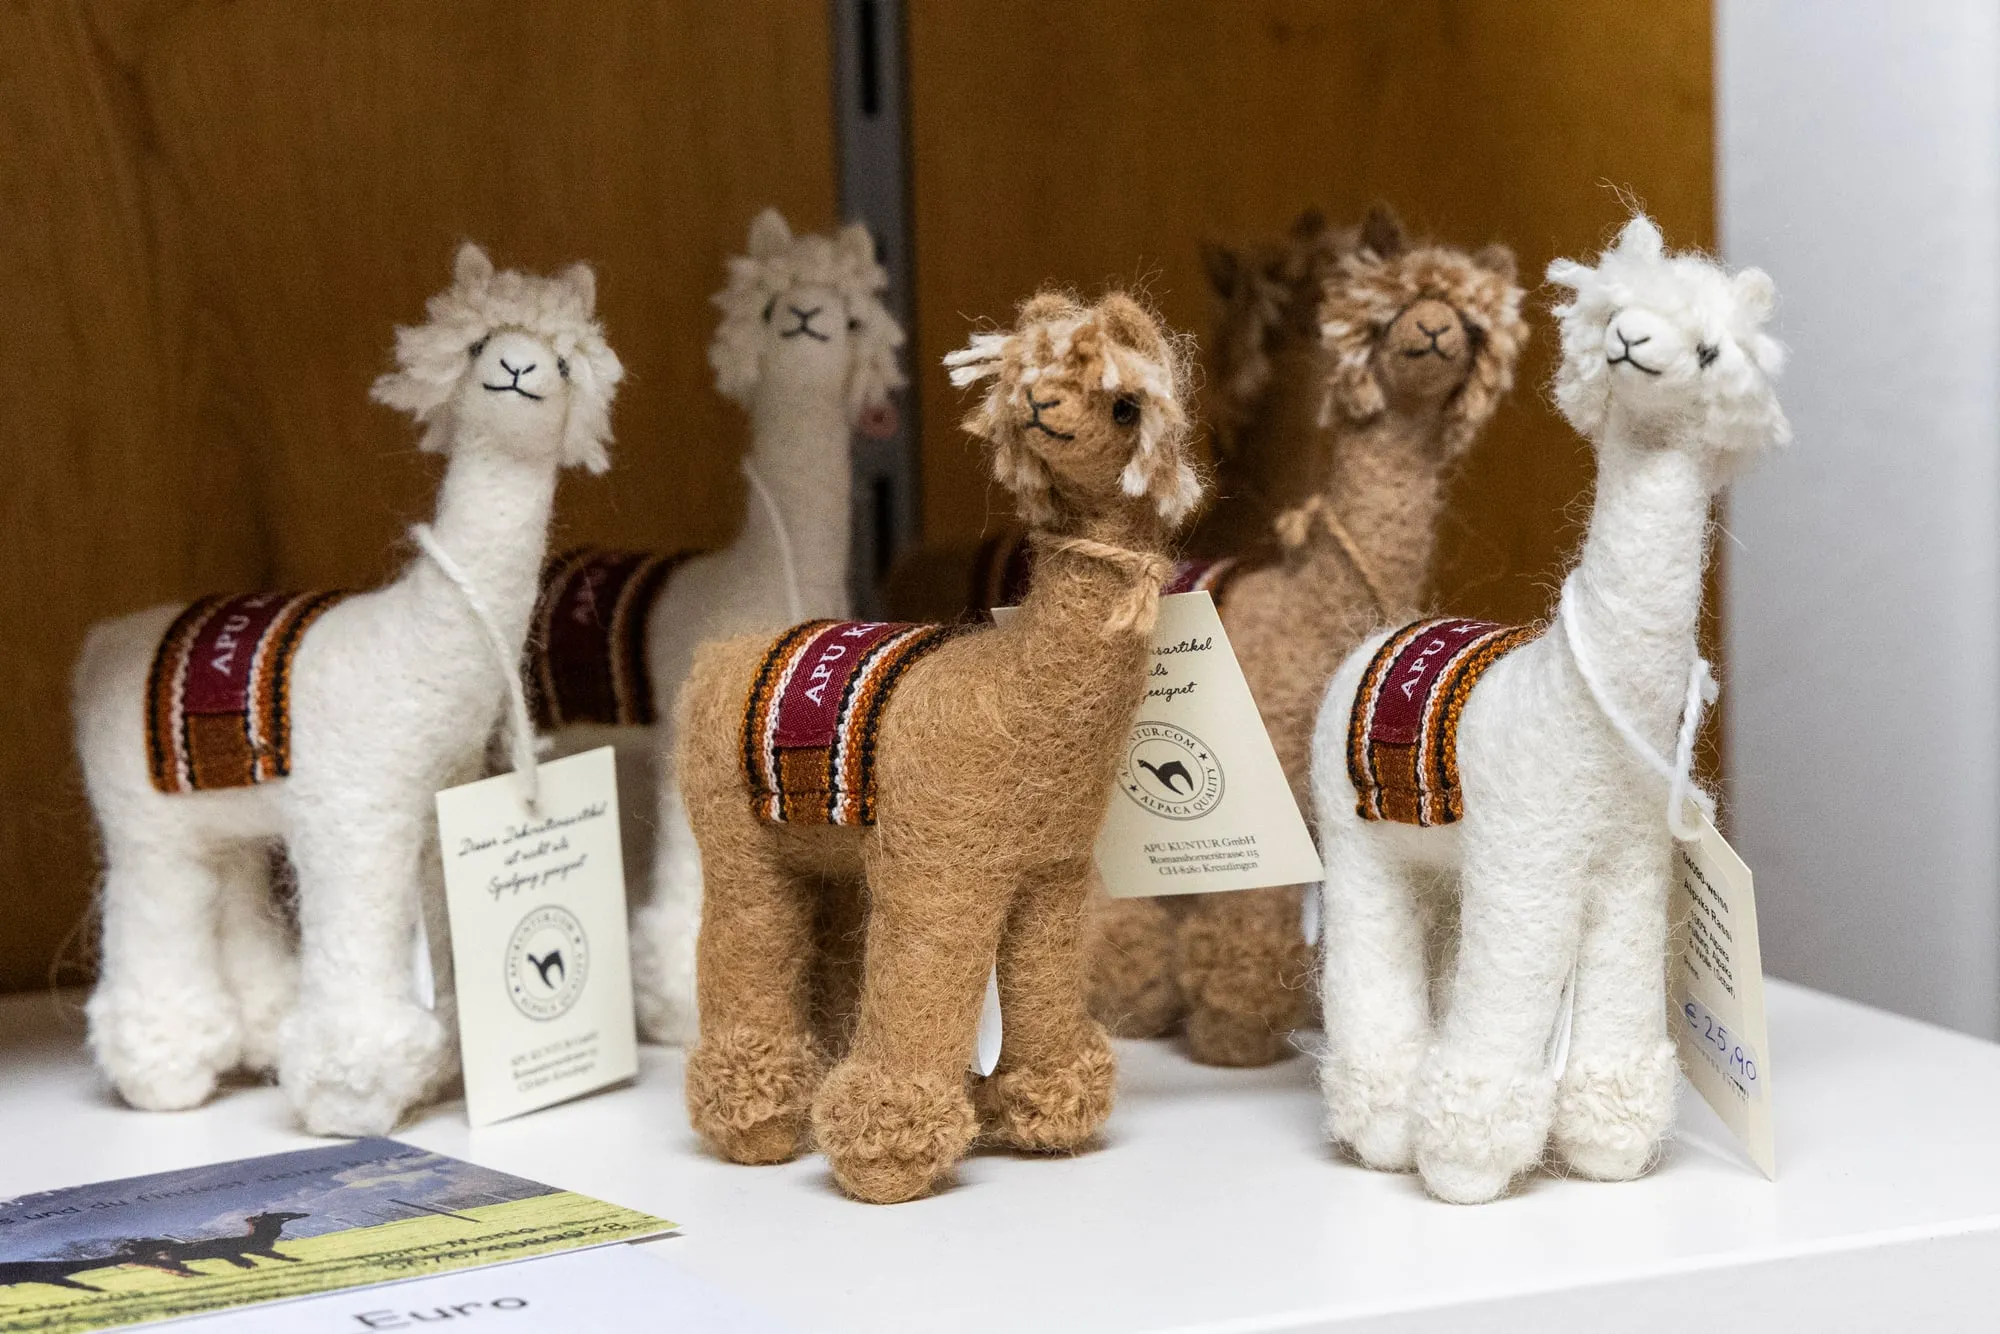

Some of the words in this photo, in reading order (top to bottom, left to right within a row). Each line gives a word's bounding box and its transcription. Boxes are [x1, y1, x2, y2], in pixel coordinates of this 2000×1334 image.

[211, 615, 250, 676] APU
[1401, 638, 1445, 701] APU
[805, 643, 846, 707] APU
[1140, 795, 1192, 815] ALPACA
[1193, 766, 1218, 811] QUALITY
[1142, 842, 1165, 853] APU
[1167, 838, 1221, 852] KUNTUR
[1221, 835, 1256, 848] GmbH
[1202, 861, 1258, 874] Kreuzlingen
[1685, 1003, 1698, 1028] €
[1704, 1015, 1756, 1080] 25,90
[25, 1206, 82, 1220] und
[90, 1200, 129, 1210] du
[354, 1296, 528, 1330] Euro
